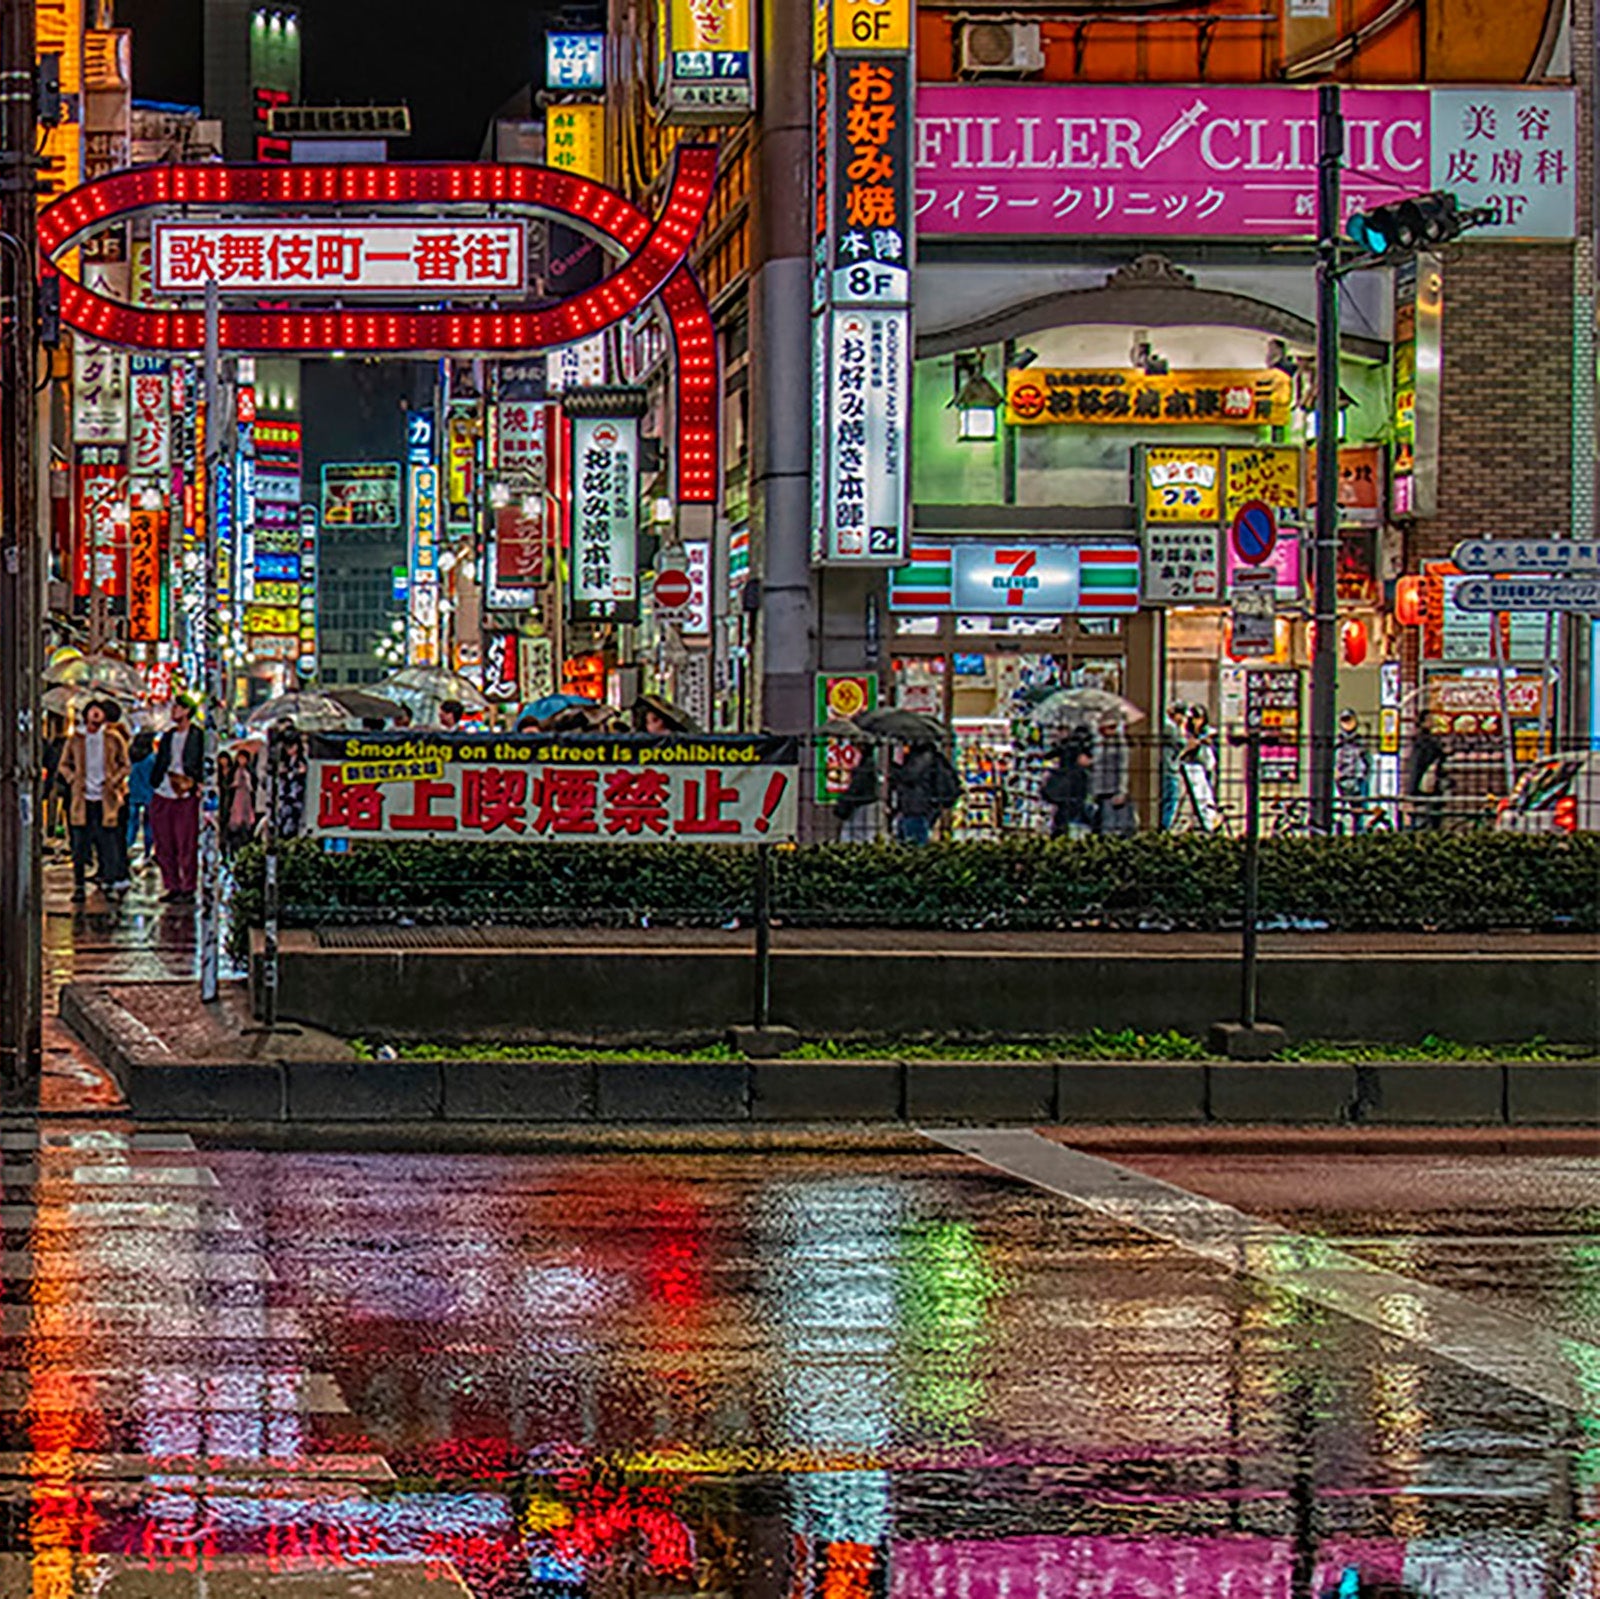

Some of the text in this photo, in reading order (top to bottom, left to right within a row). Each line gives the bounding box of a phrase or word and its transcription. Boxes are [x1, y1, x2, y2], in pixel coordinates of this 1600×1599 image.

[852, 10, 891, 41] 6F
[716, 52, 742, 75] 7F
[1464, 104, 1551, 141] 美容
[846, 62, 897, 226] お好み焼
[914, 117, 1423, 172] FILLER CLIIC
[1446, 148, 1569, 185] 皮膚科
[914, 185, 1225, 220] フィラー クリニック
[1295, 194, 1368, 216] 新院
[168, 233, 511, 282] 歌舞伎町一番街
[849, 267, 892, 295] 8F
[836, 338, 867, 528] お好み焼き本陣
[872, 529, 897, 551] 2F
[994, 550, 1038, 606] 7
[345, 740, 762, 764] Smorking on the street is prohibited.
